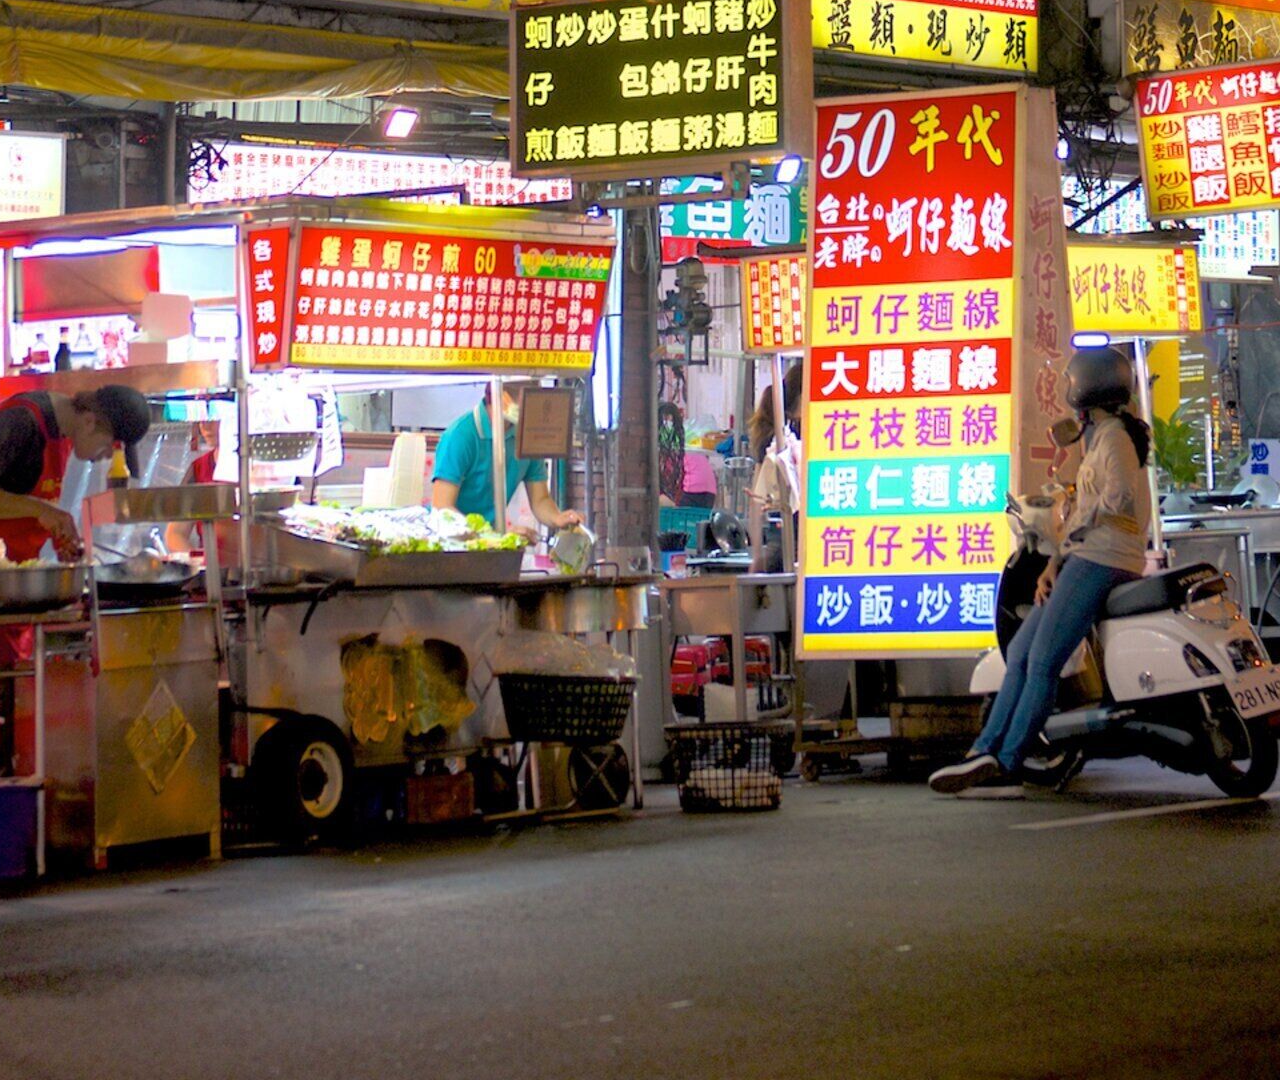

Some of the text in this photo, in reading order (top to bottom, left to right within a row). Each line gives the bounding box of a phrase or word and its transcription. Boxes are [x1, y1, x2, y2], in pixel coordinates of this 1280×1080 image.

[827, 289, 1000, 335] 蚵仔麵線
[821, 346, 998, 397] 大腸麵線
[823, 404, 998, 451] 花枝麵線
[820, 461, 998, 511] 蝦仁麵線
[820, 522, 997, 568] 筒仔米糕
